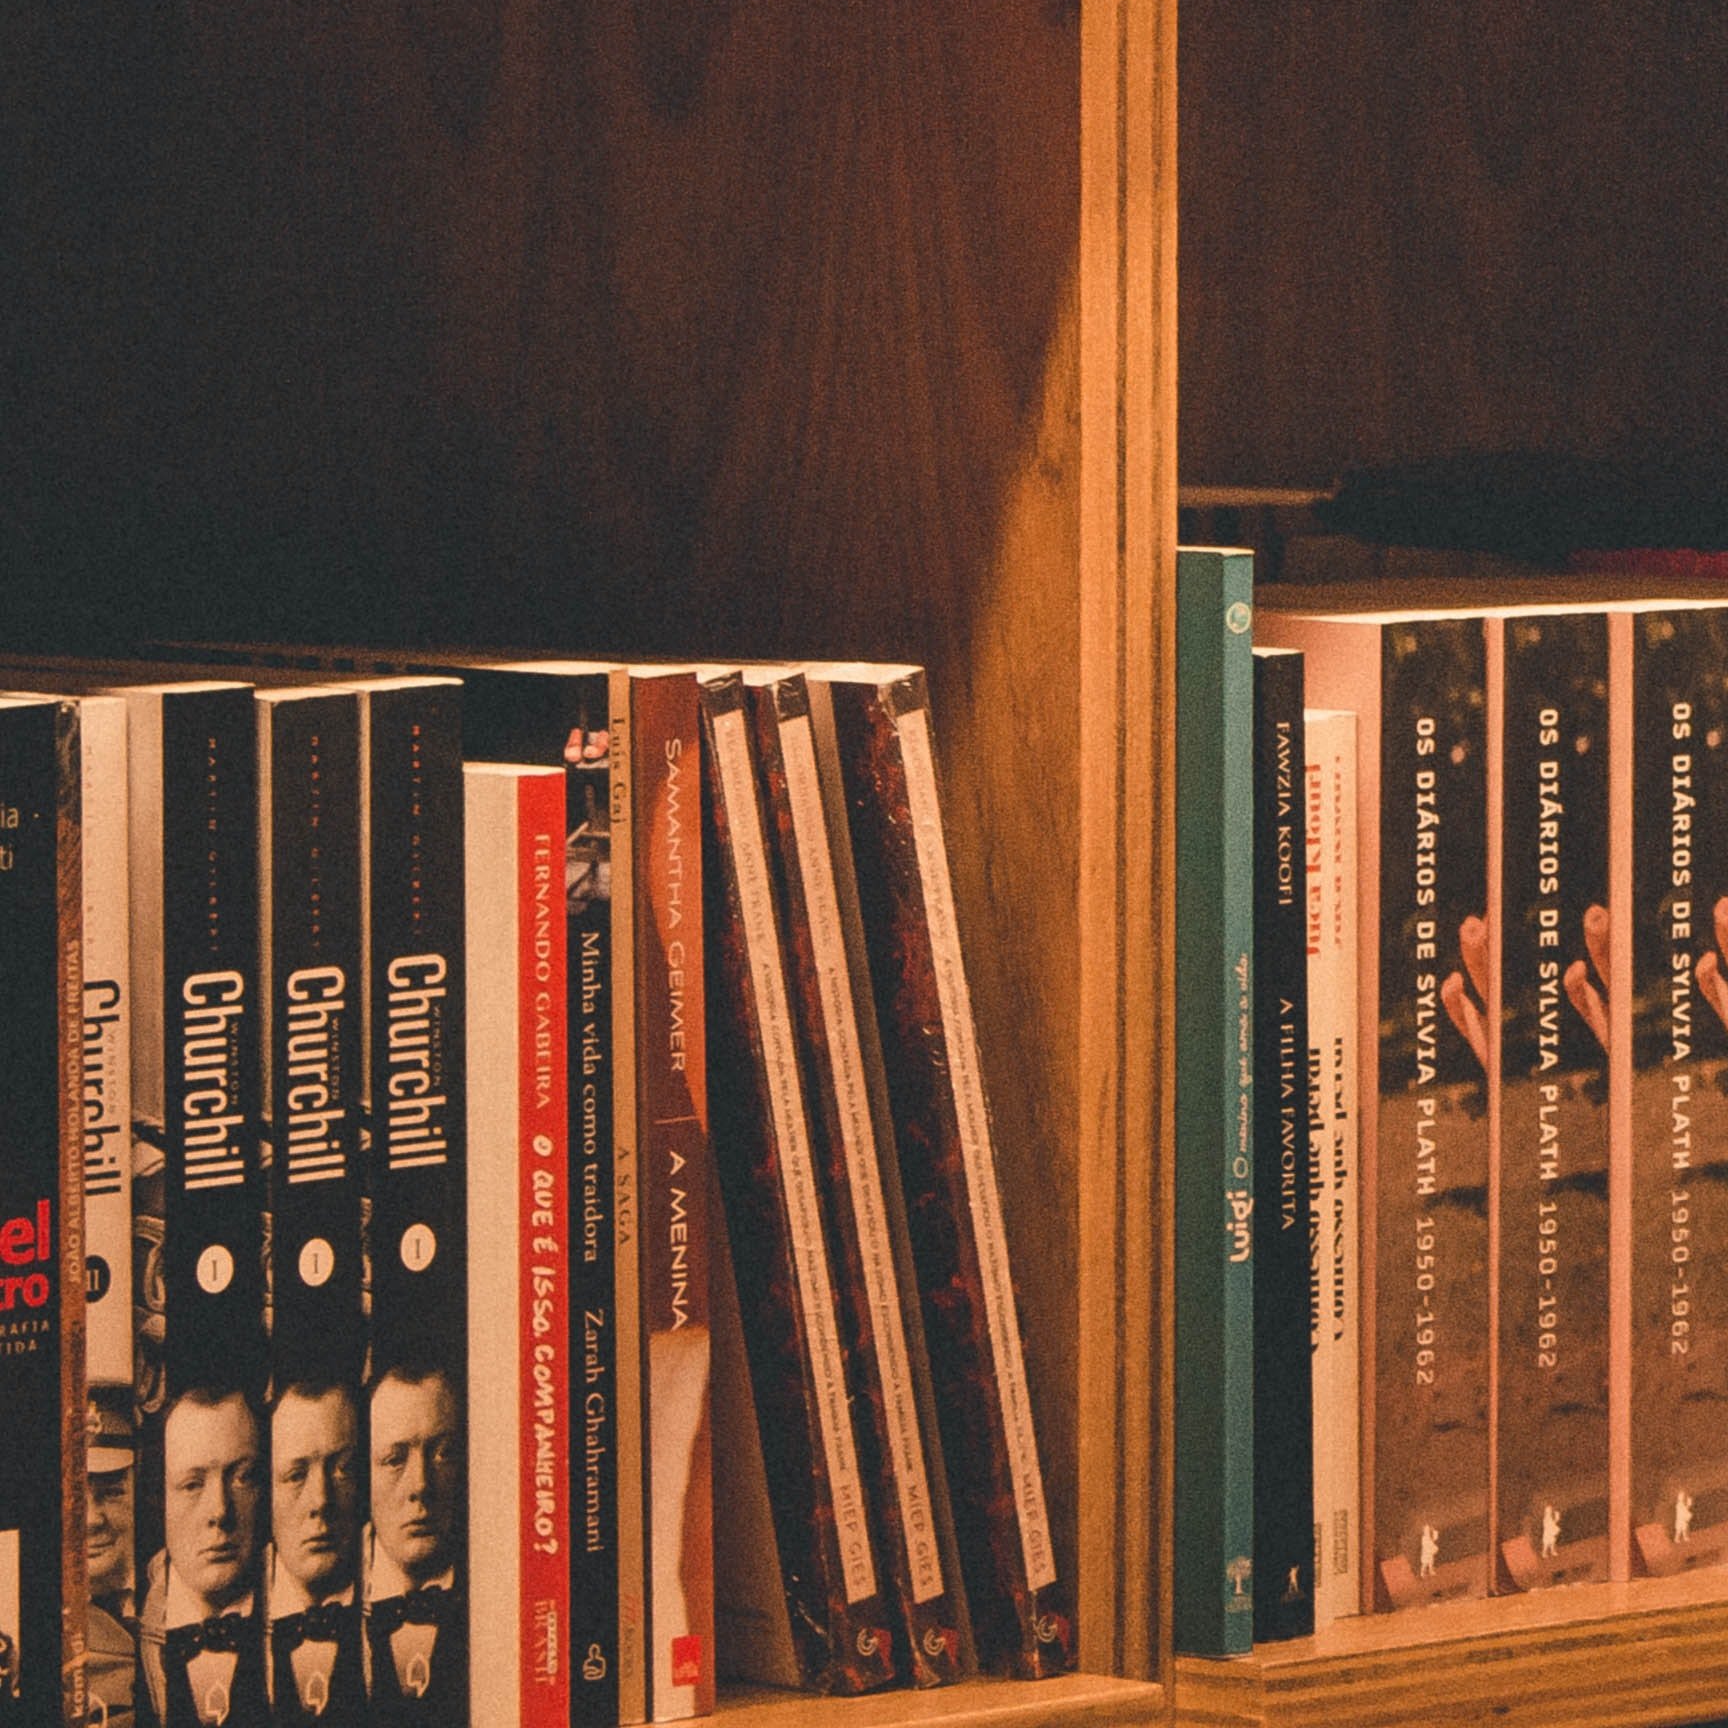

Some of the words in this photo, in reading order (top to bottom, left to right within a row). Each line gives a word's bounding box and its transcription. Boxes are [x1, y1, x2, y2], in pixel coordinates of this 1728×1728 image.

[1276, 721, 1292, 817] FAWZIA
[1417, 718, 1436, 756] OS
[665, 738, 683, 930] SAMANTHA
[1278, 827, 1292, 906] KOOFI
[1416, 770, 1439, 907] DIÁRIOS
[534, 833, 552, 983] FERNANDO
[1416, 921, 1436, 960] DE
[581, 931, 601, 1014] Minha
[668, 941, 686, 1072] GEIMER
[1280, 998, 1293, 1015] A
[387, 953, 448, 1171] Churchill
[535, 992, 552, 1111] GABEIRA
[583, 1021, 602, 1075] vida
[1237, 1057, 1252, 1087] que
[1279, 1026, 1294, 1106] FILHA
[1416, 973, 1437, 1085] SYLVIA
[82, 978, 121, 1197] Churchill
[183, 970, 245, 1191] Churchill
[287, 966, 346, 1184] Churchill
[533, 1134, 553, 1157] O
[583, 1086, 595, 1155] como
[670, 1151, 686, 1176] A
[1237, 1094, 1249, 1153] menino
[1417, 1099, 1436, 1195] PLATH
[532, 1170, 555, 1228] QUE
[582, 1160, 599, 1263] traidora
[617, 1173, 630, 1246] SAGA
[1233, 1157, 1248, 1178] O
[1281, 1114, 1296, 1229] FAVORITA
[533, 1232, 559, 1254] É
[669, 1187, 689, 1333] MENINA
[1227, 1189, 1254, 1263] Luigi
[1415, 1217, 1434, 1385] 1950-1962
[583, 1307, 605, 1387] Zarah
[532, 1343, 559, 1557] COMPANHEIRO?
[585, 1391, 607, 1553] Ghahramani
